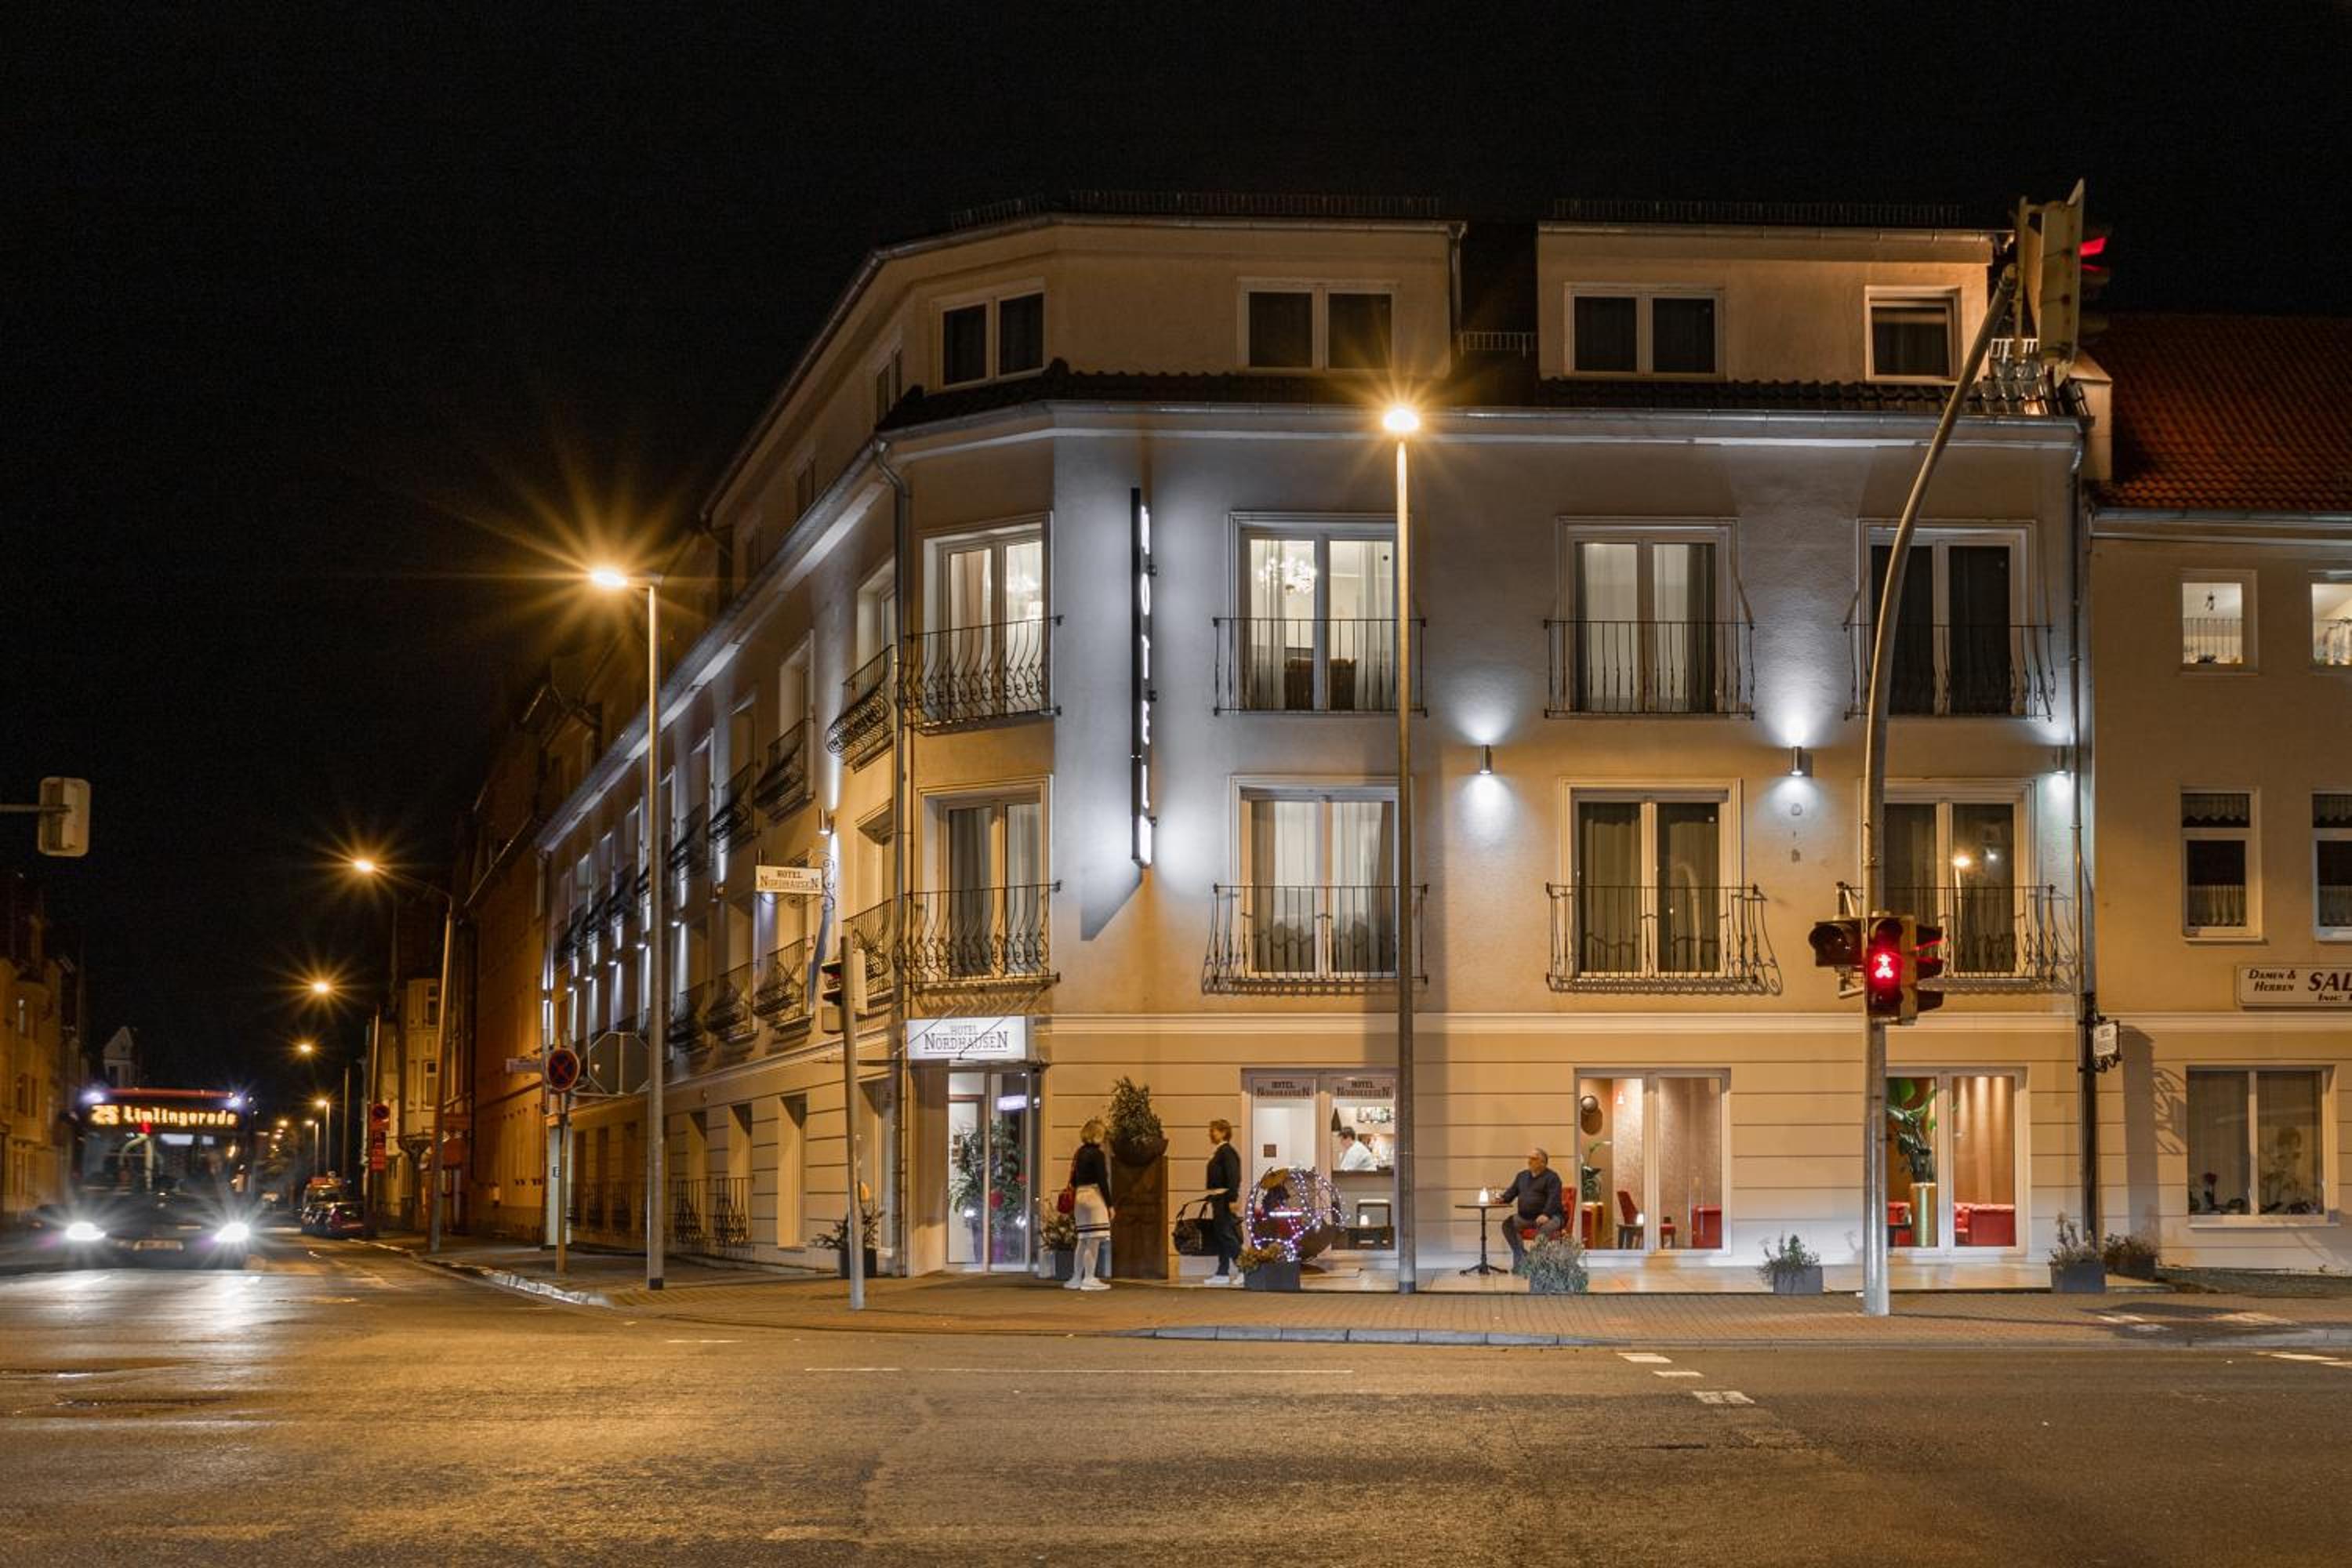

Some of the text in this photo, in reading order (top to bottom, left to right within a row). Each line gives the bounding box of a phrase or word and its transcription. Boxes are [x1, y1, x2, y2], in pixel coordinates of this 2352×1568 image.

[2249, 969, 2296, 979] DAMEN &
[2254, 981, 2294, 991] HERREN
[950, 1025, 978, 1035] HOTEL
[924, 1031, 1008, 1050] NORDHAUSEN
